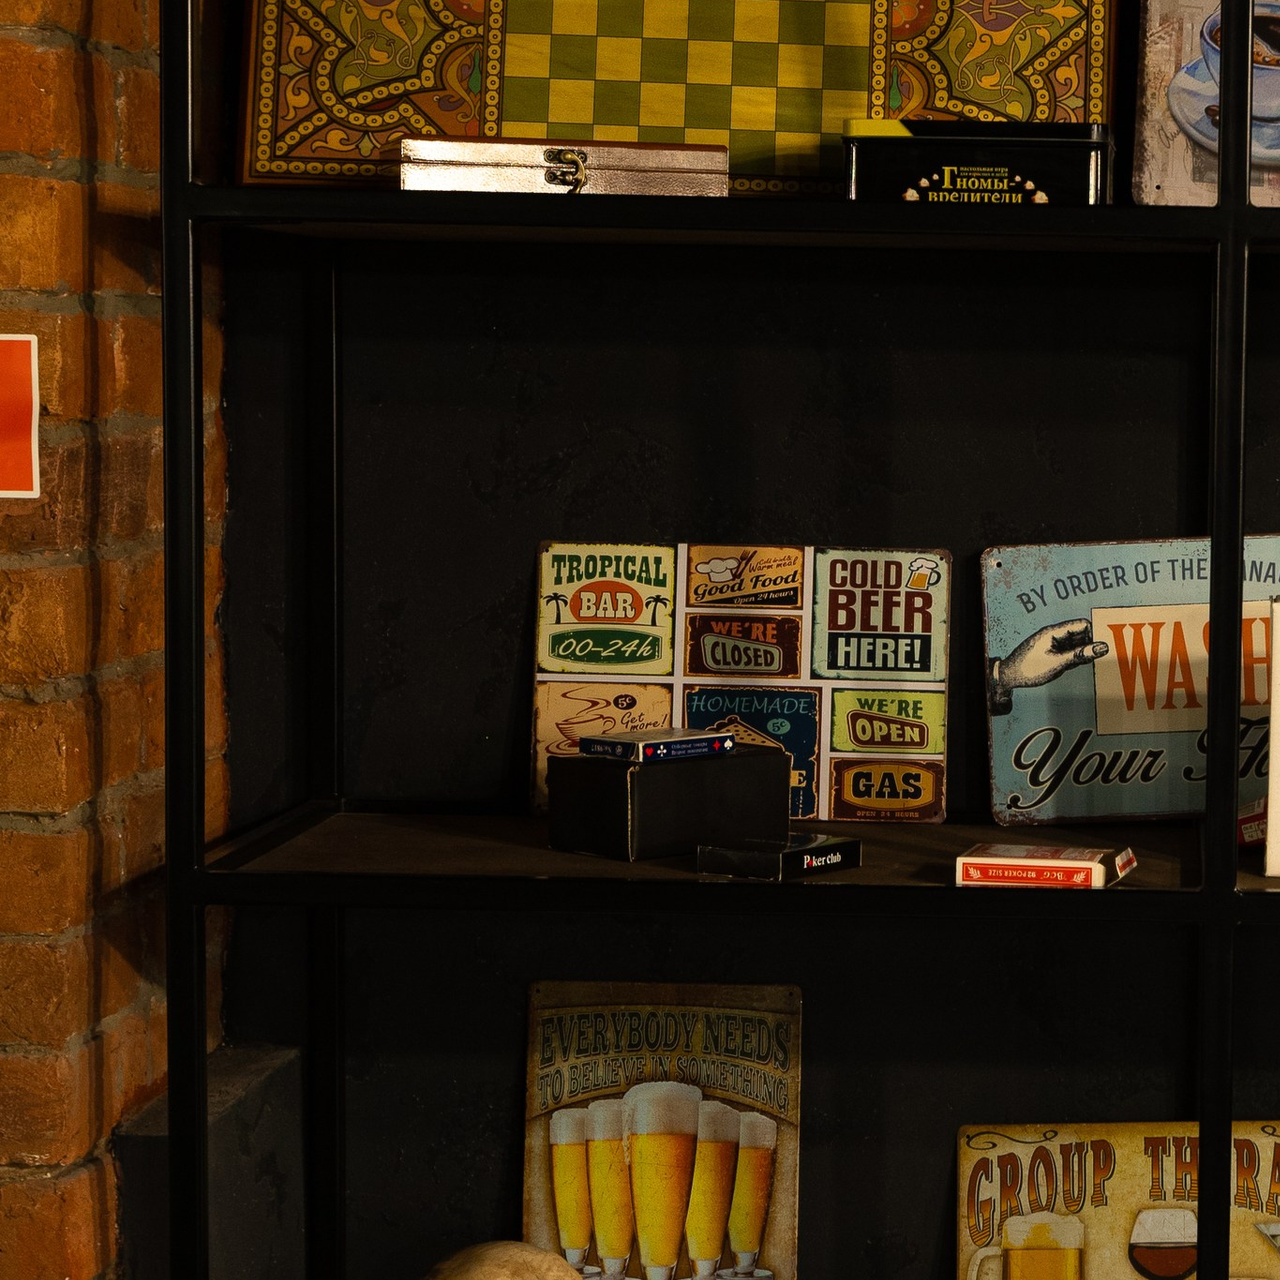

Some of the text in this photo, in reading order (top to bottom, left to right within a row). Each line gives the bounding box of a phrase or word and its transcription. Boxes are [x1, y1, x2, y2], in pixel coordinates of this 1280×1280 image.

[941, 166, 1017, 190] Гномы-
[551, 554, 667, 588] TROPICAL
[749, 556, 799, 573] Warm meal
[829, 559, 903, 589] COLD
[693, 570, 799, 602] Good Food
[734, 590, 794, 605] Open 24 hours
[1017, 585, 1048, 614] BY
[1054, 565, 1129, 600] ORDER
[1135, 561, 1160, 583] OF
[1167, 558, 1208, 581] THE
[579, 591, 636, 619] BAR
[828, 589, 933, 633] BEER
[709, 620, 778, 644] WE'RE
[559, 636, 653, 657] 00-24h
[710, 640, 775, 667] CLOSED
[837, 636, 921, 669] HERE!
[1107, 617, 1271, 712] WAH
[691, 695, 810, 714] HOMEMADE
[856, 698, 924, 720] WE'RE
[620, 711, 645, 729] Get
[629, 714, 668, 732] more!
[855, 717, 921, 742] OPEN
[1007, 726, 1167, 811] Your
[852, 771, 922, 800] GAS
[826, 852, 841, 864] club
[988, 869, 1003, 877] SIZE
[539, 1011, 790, 1071] EVERYBODY NEEDS
[538, 1055, 789, 1115] TO BELIEVE IN SOMETHING
[967, 1139, 1115, 1247] GROUP
